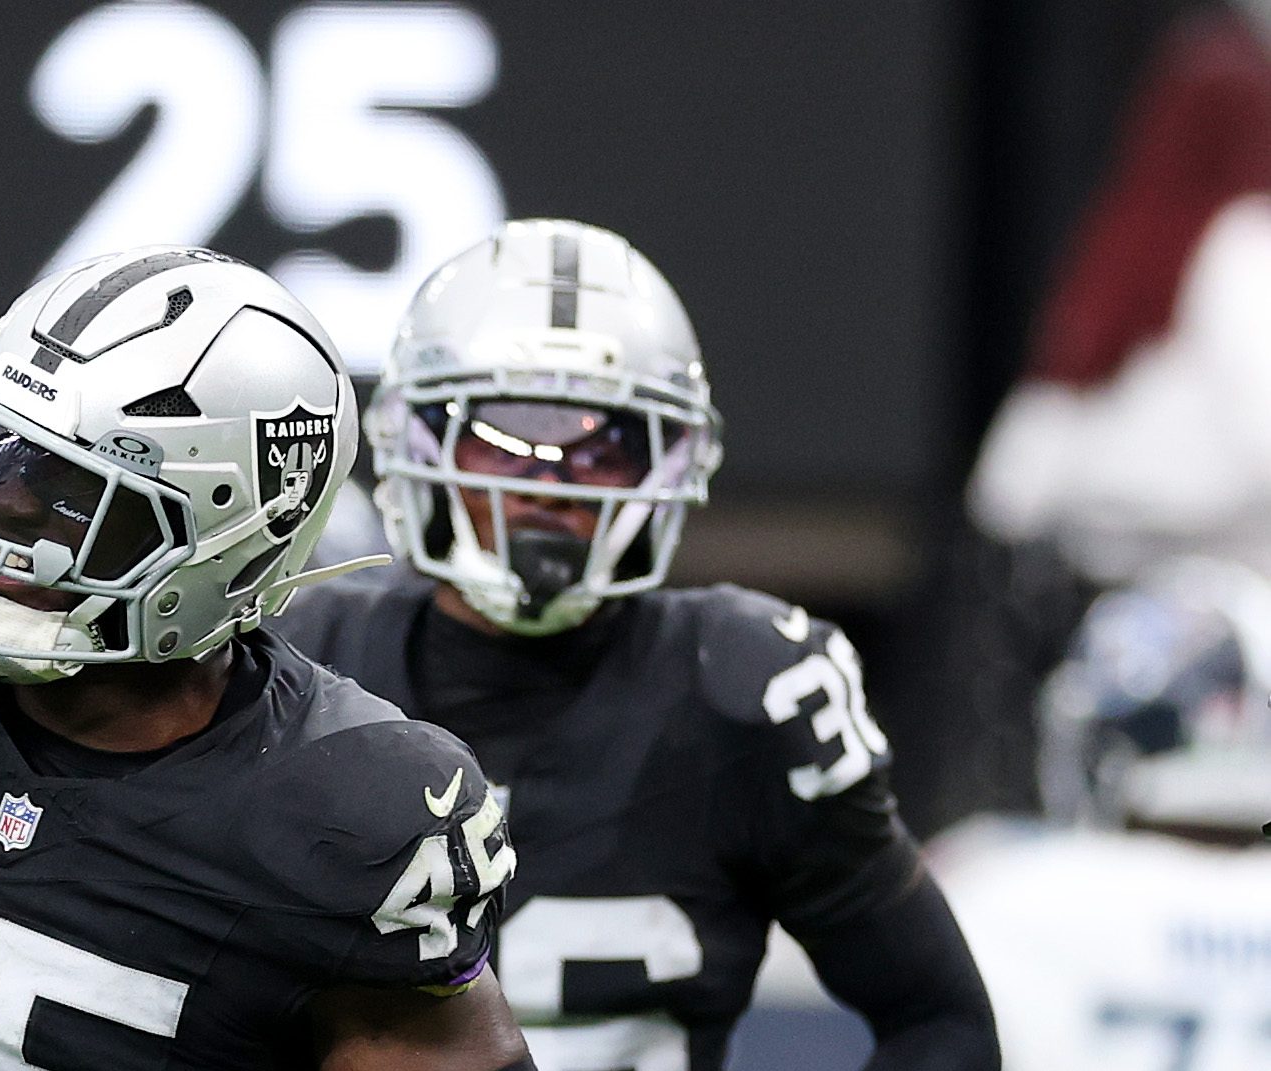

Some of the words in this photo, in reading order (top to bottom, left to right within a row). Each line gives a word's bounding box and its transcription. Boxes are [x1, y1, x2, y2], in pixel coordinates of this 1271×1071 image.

[29, 0, 505, 376] 25
[2, 365, 59, 402] RAIDERS
[265, 418, 330, 438] RAIDERS
[99, 445, 157, 467] OAKLEY
[0, 815, 27, 841] NFL
[371, 784, 517, 962] 45
